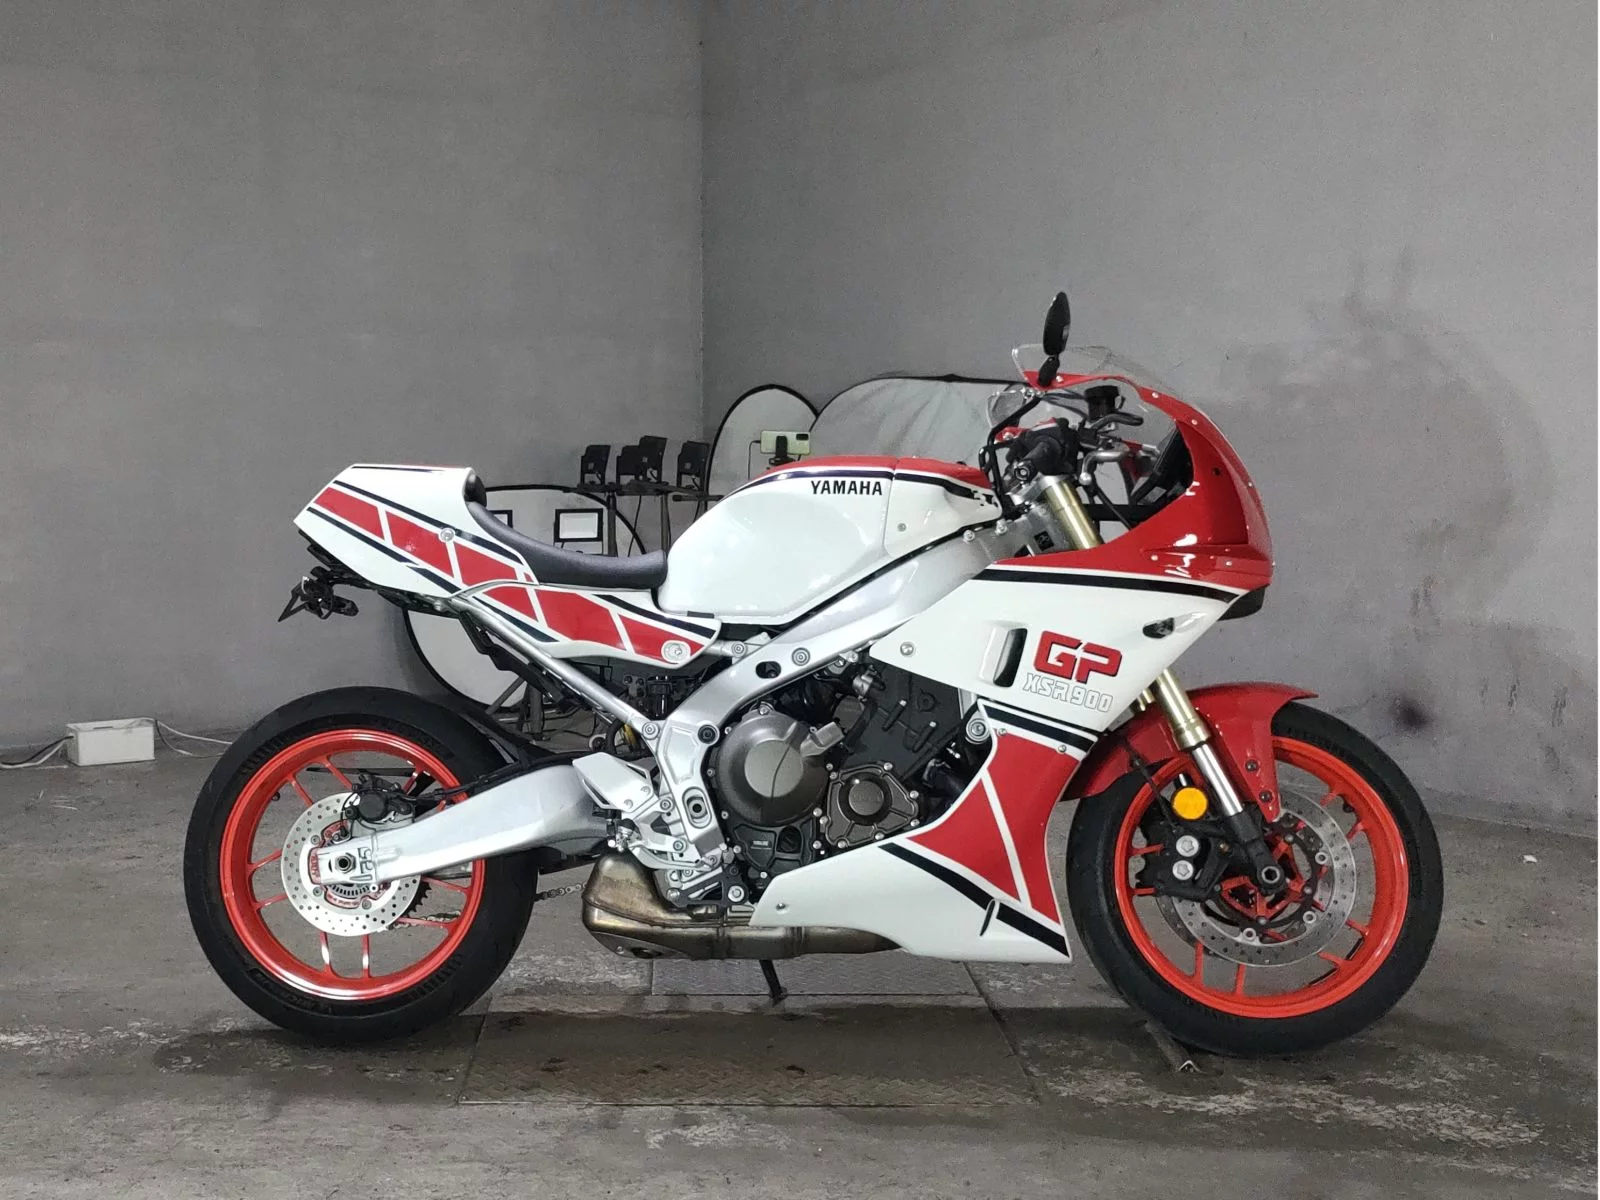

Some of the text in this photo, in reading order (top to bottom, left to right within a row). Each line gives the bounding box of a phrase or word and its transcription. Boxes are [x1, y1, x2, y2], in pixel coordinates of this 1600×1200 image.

[811, 480, 882, 496] YAMAHA
[1034, 630, 1123, 685] GP
[1022, 672, 1114, 713] XSR900
